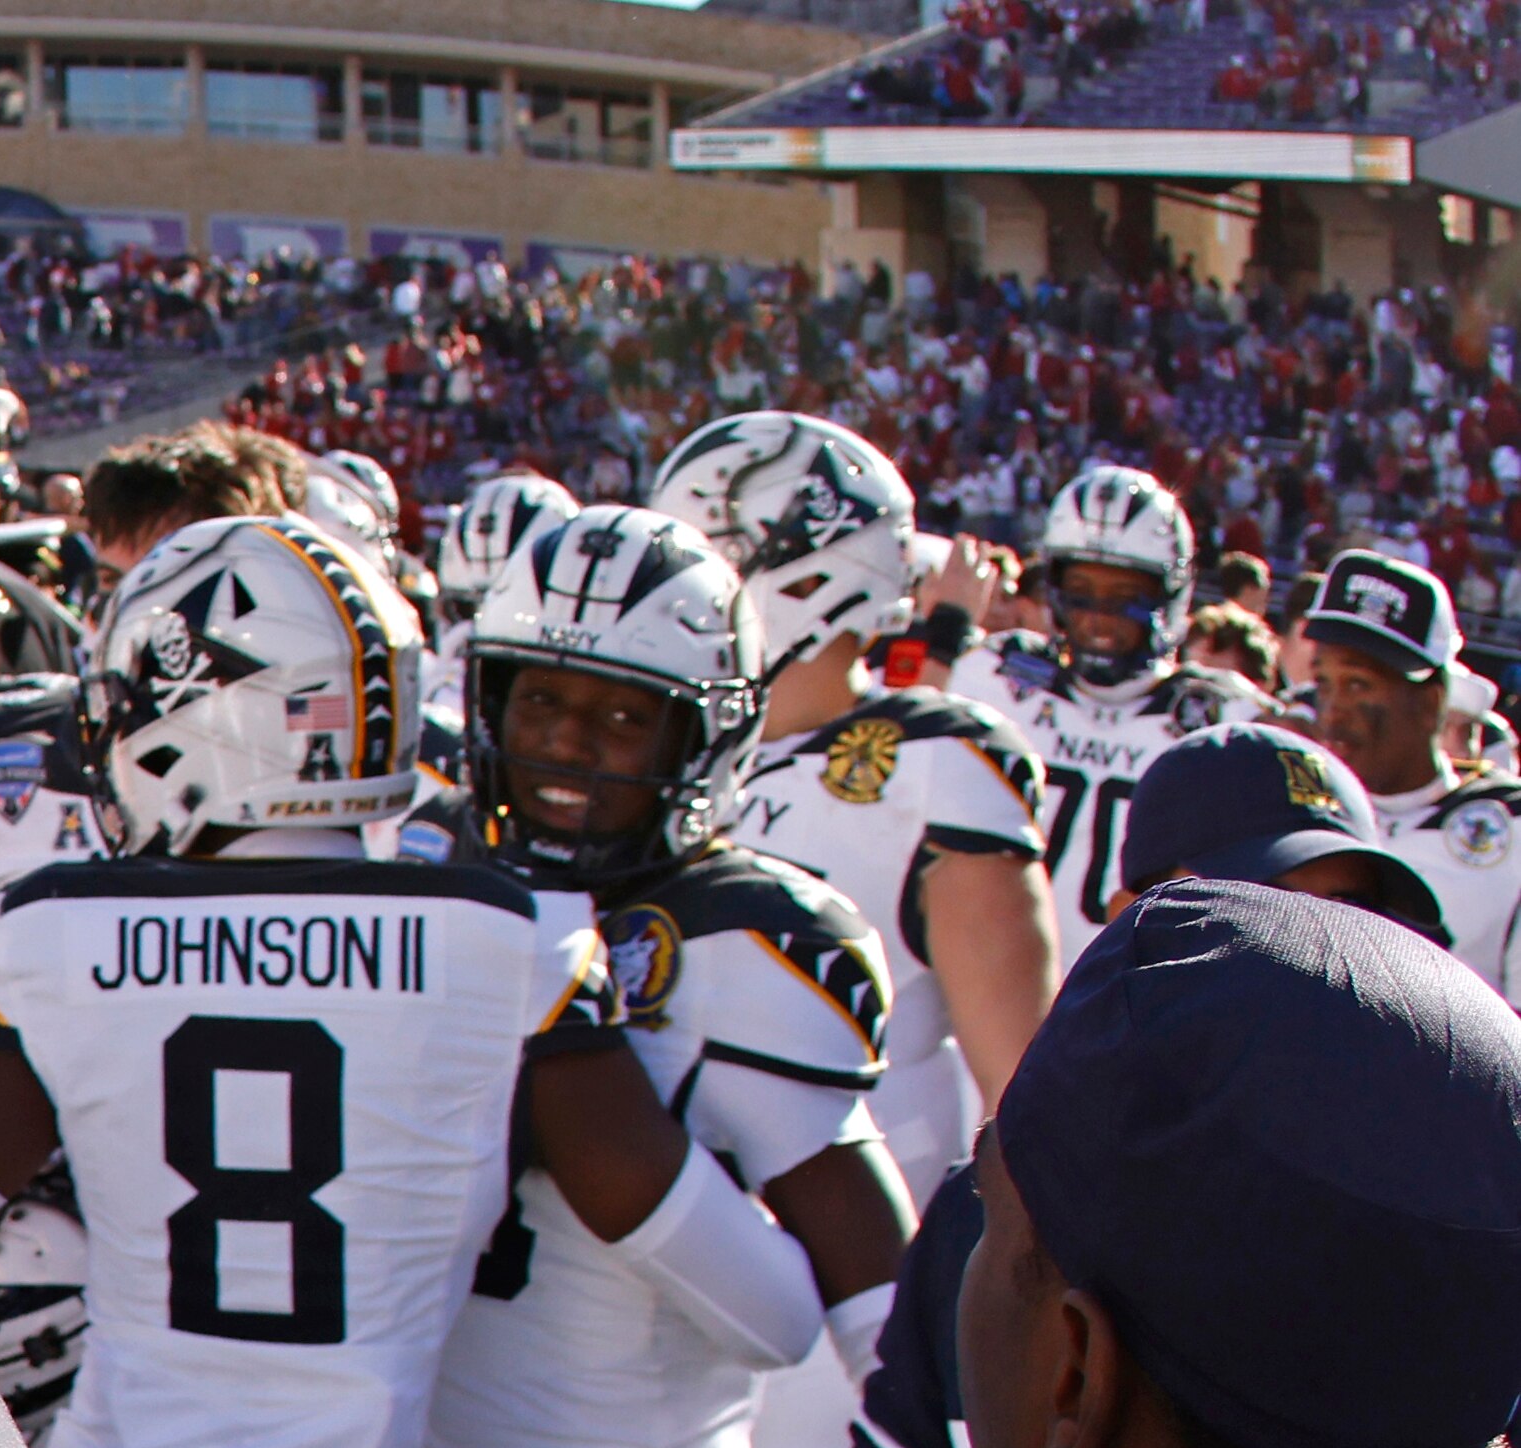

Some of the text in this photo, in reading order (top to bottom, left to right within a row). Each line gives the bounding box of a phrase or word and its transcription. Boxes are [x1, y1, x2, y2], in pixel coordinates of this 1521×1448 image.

[1054, 734, 1147, 770] NAVY
[266, 800, 333, 818] FEAR
[92, 916, 382, 991] JOHNSON
[163, 1014, 347, 1346] 8
